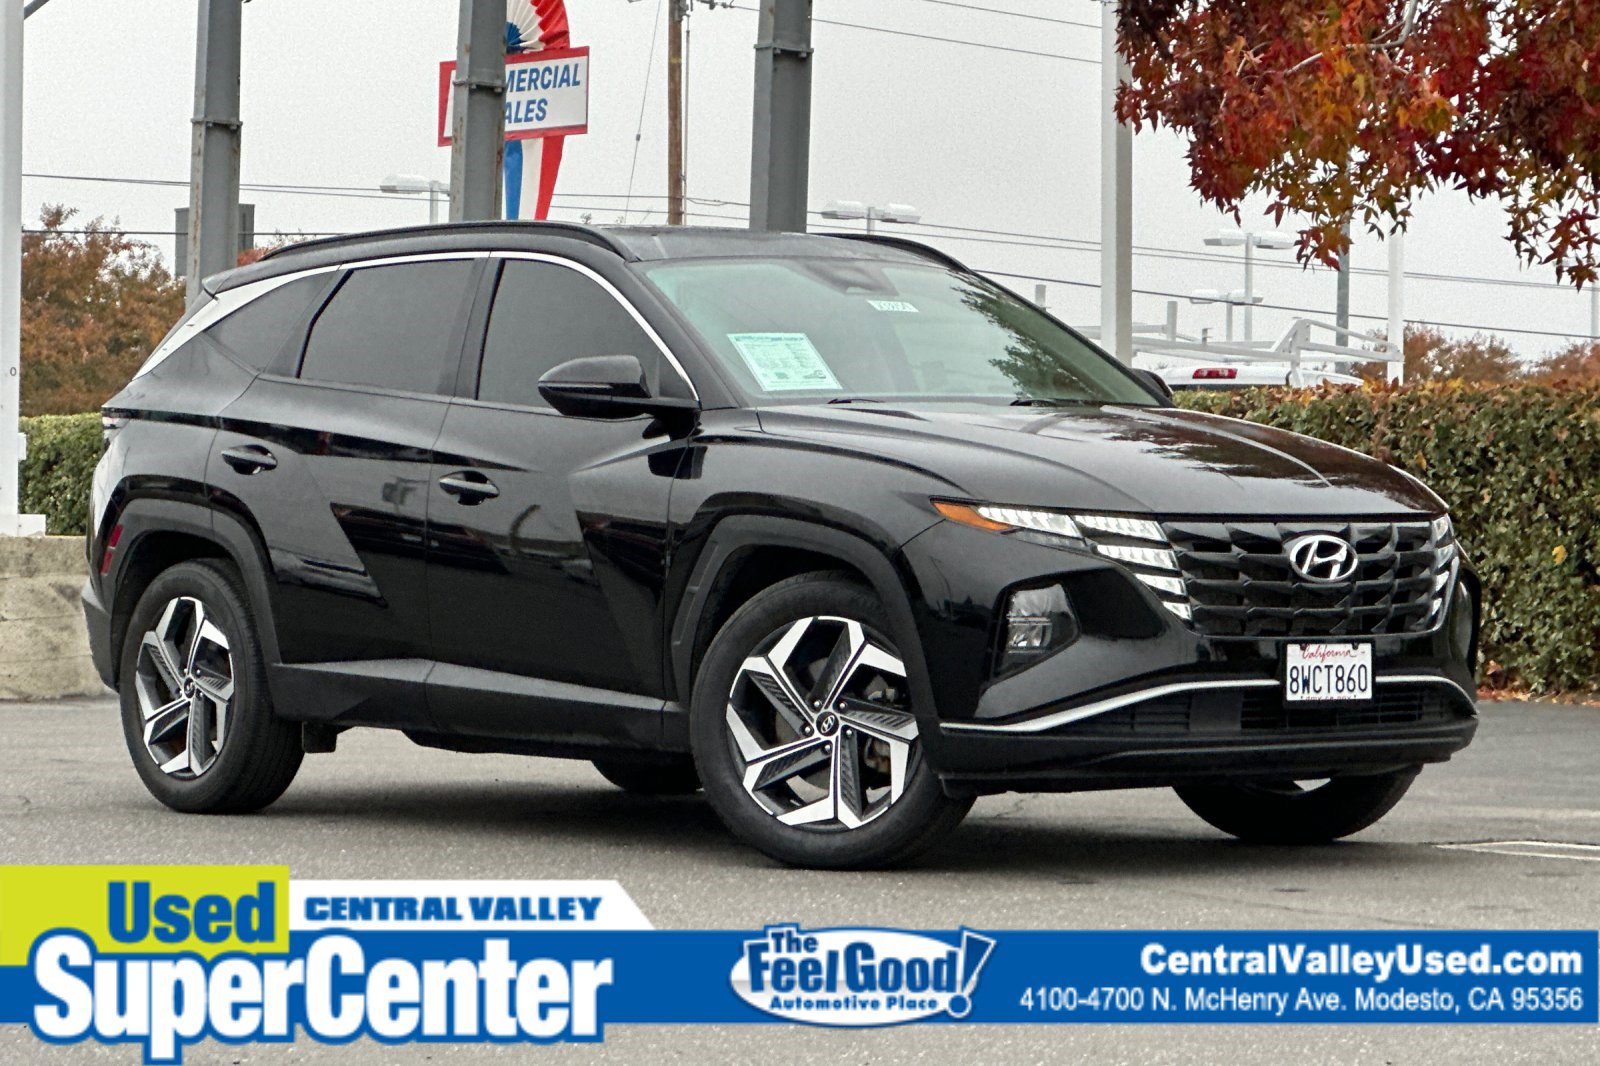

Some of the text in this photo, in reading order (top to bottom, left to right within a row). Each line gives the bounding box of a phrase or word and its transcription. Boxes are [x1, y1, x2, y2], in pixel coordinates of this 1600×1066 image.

[505, 97, 548, 124] ALES
[1303, 644, 1356, 663] California
[1289, 664, 1368, 694] 8WCT860
